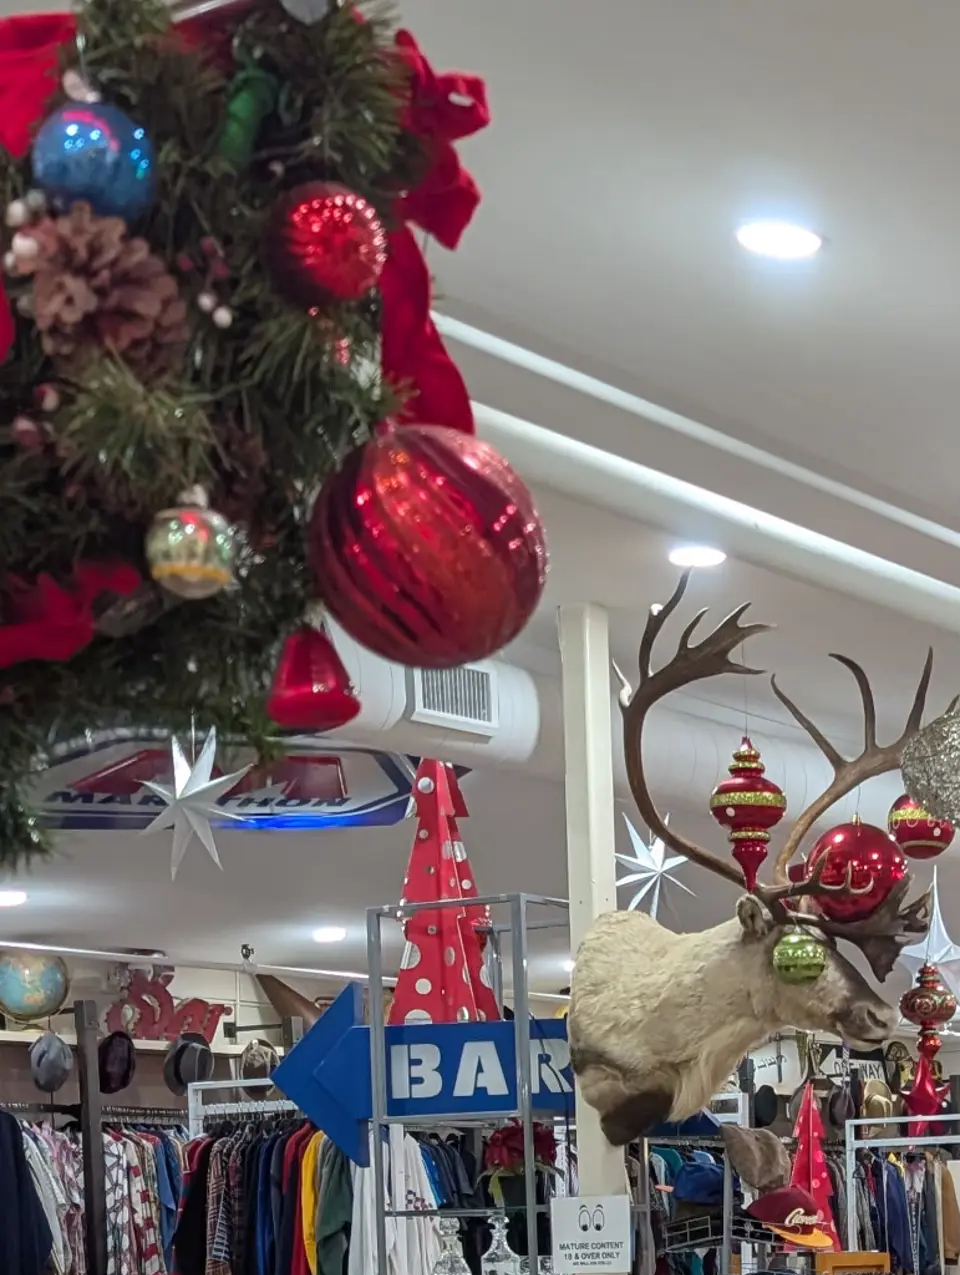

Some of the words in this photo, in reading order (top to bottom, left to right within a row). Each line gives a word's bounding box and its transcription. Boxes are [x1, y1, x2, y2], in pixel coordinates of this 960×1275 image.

[46, 789, 352, 808] MARTHON
[390, 1038, 574, 1099] BAR
[559, 1242, 590, 1251] MATURE
[591, 1241, 624, 1250] CONTENT
[574, 1252, 580, 1260] &
[581, 1252, 601, 1260] OVER
[601, 1251, 621, 1259] ONLY
